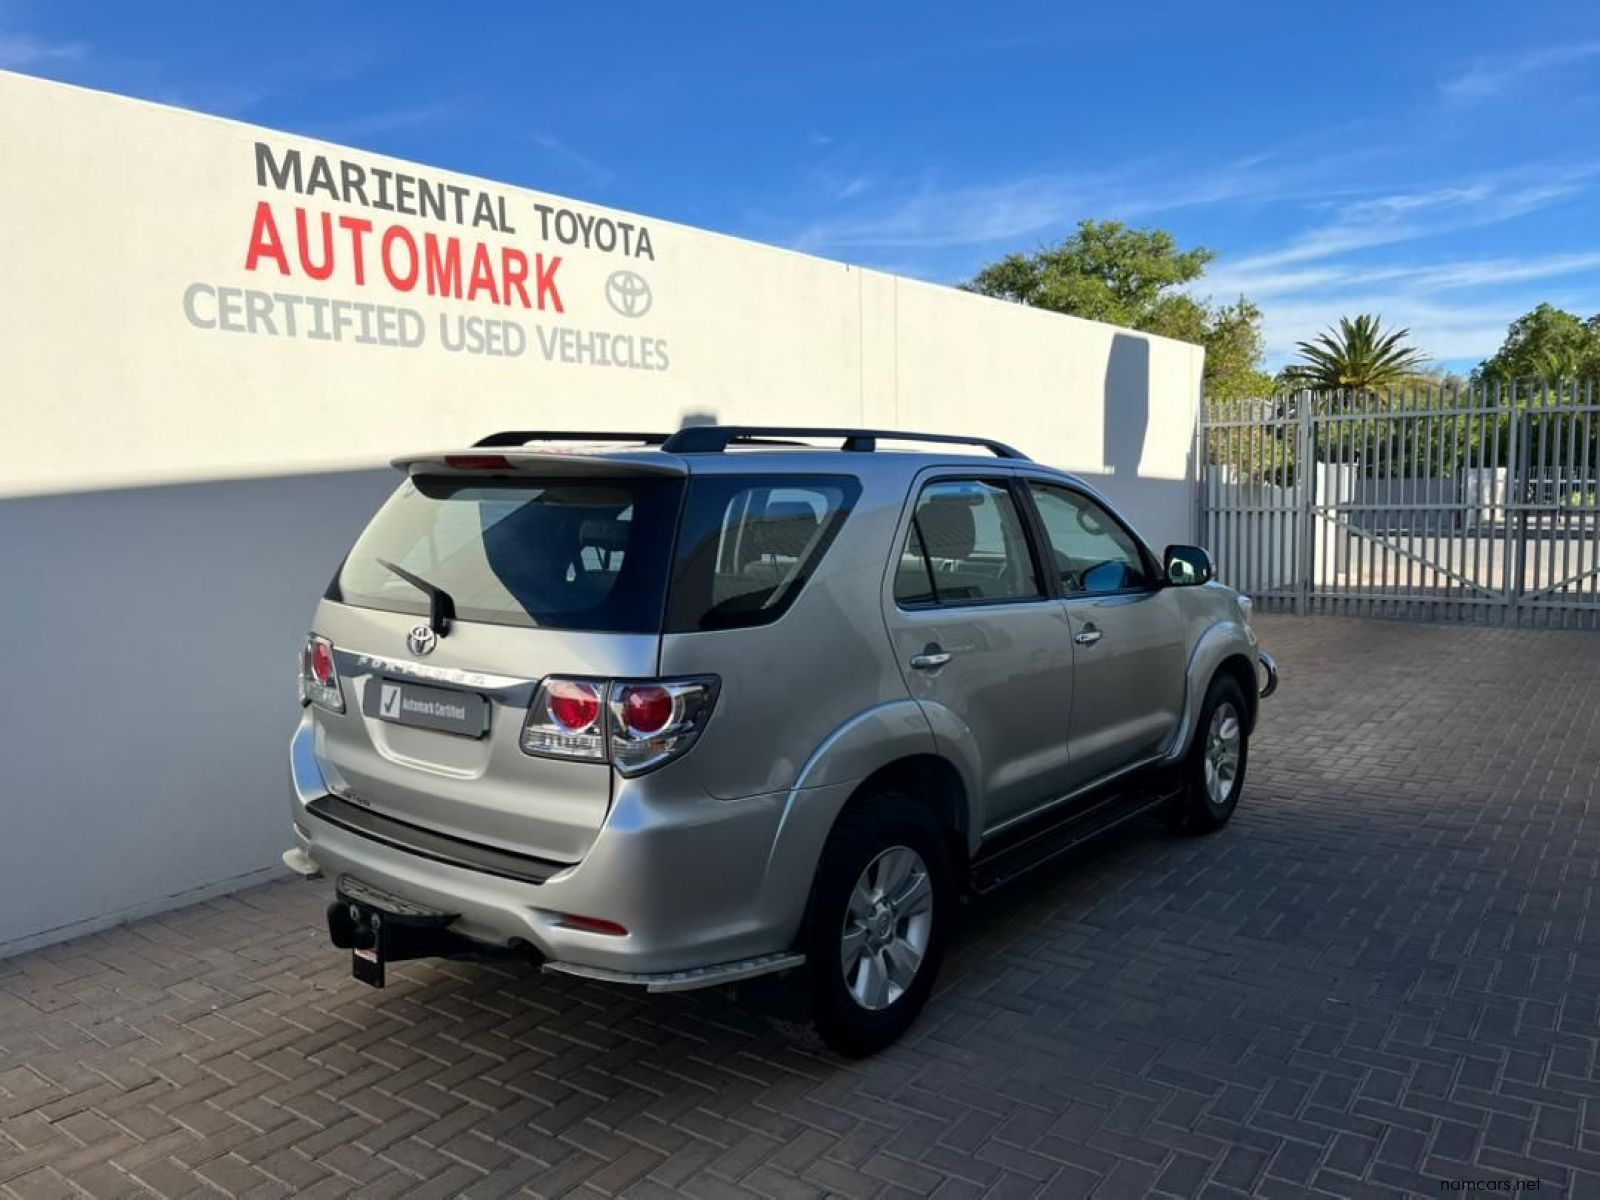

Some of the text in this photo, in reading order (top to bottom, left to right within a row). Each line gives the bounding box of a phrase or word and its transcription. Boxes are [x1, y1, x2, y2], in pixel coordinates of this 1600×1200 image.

[254, 141, 655, 261] MARIENTAL TOYOTA
[244, 201, 564, 314] AUTOMARK
[183, 282, 669, 371] CERTIFIED USED VEHICLES
[402, 698, 434, 715] Automark
